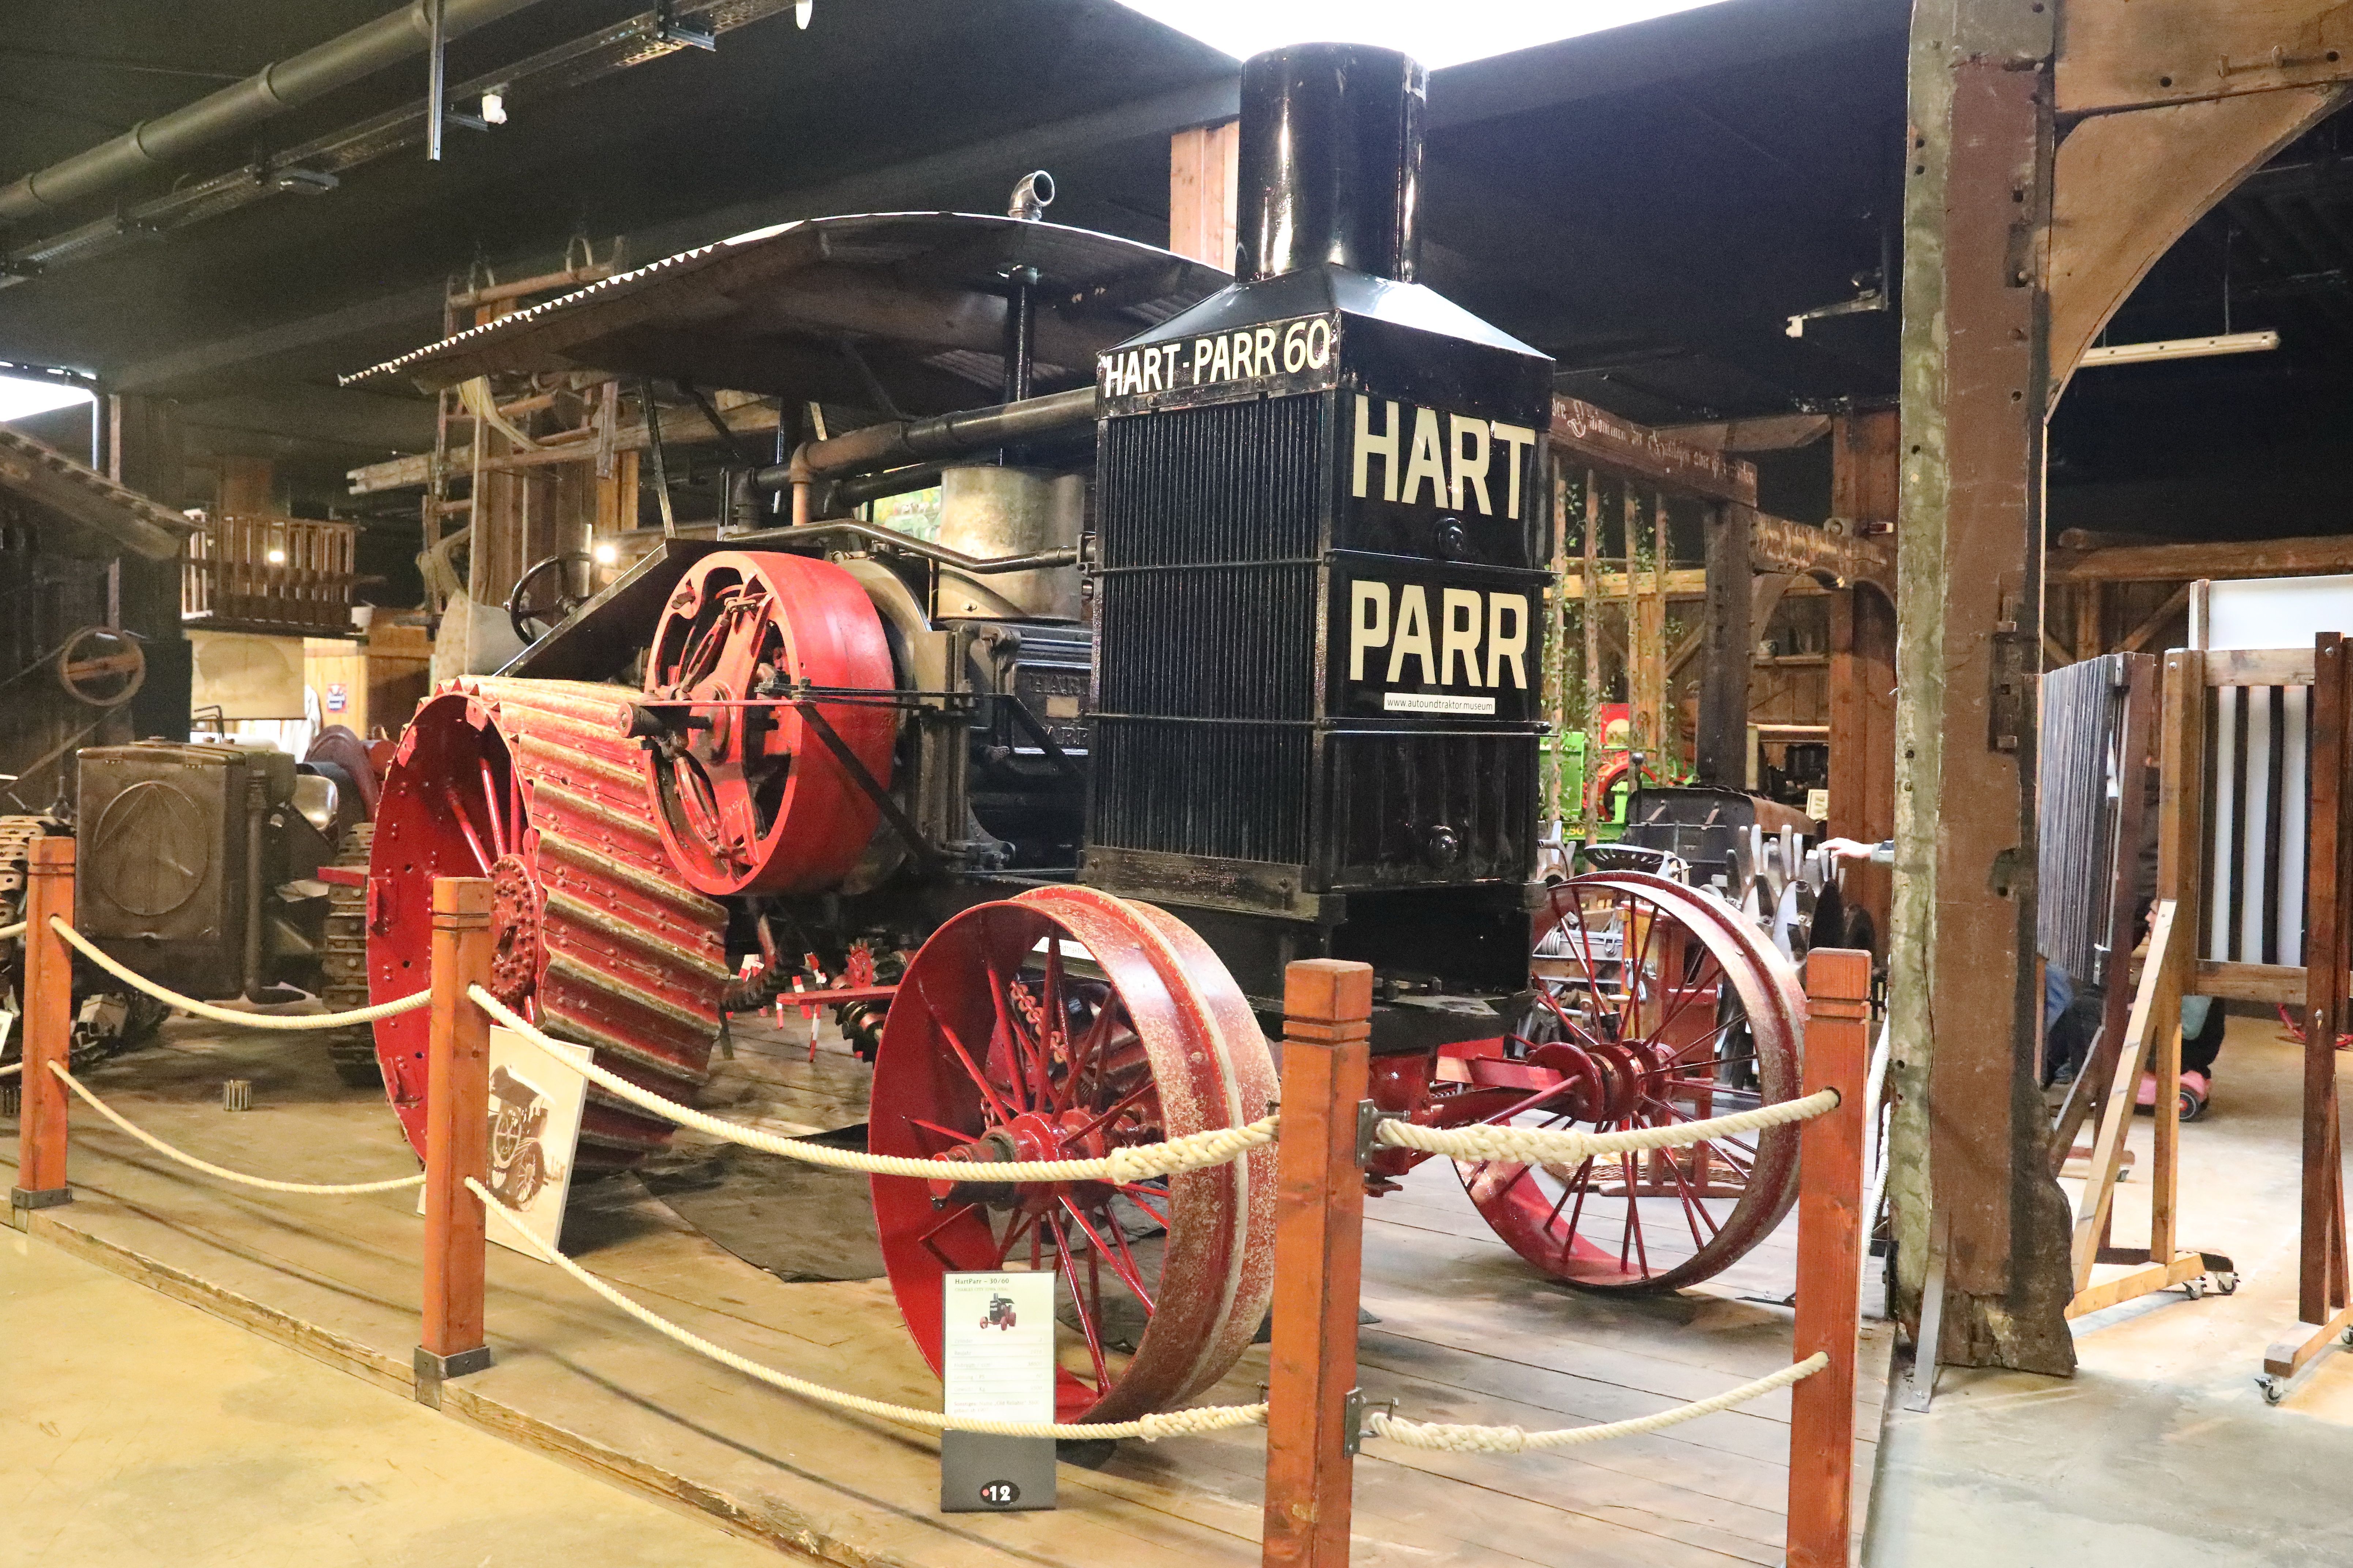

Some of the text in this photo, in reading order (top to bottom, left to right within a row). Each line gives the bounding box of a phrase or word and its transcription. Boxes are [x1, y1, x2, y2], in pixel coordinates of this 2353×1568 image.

[1283, 318, 1330, 373] 60
[1352, 393, 1535, 520] HART
[1349, 580, 1528, 689] PARR
[1387, 699, 1492, 710] www.autoundtraktor.museum
[990, 1485, 1010, 1501] 12
